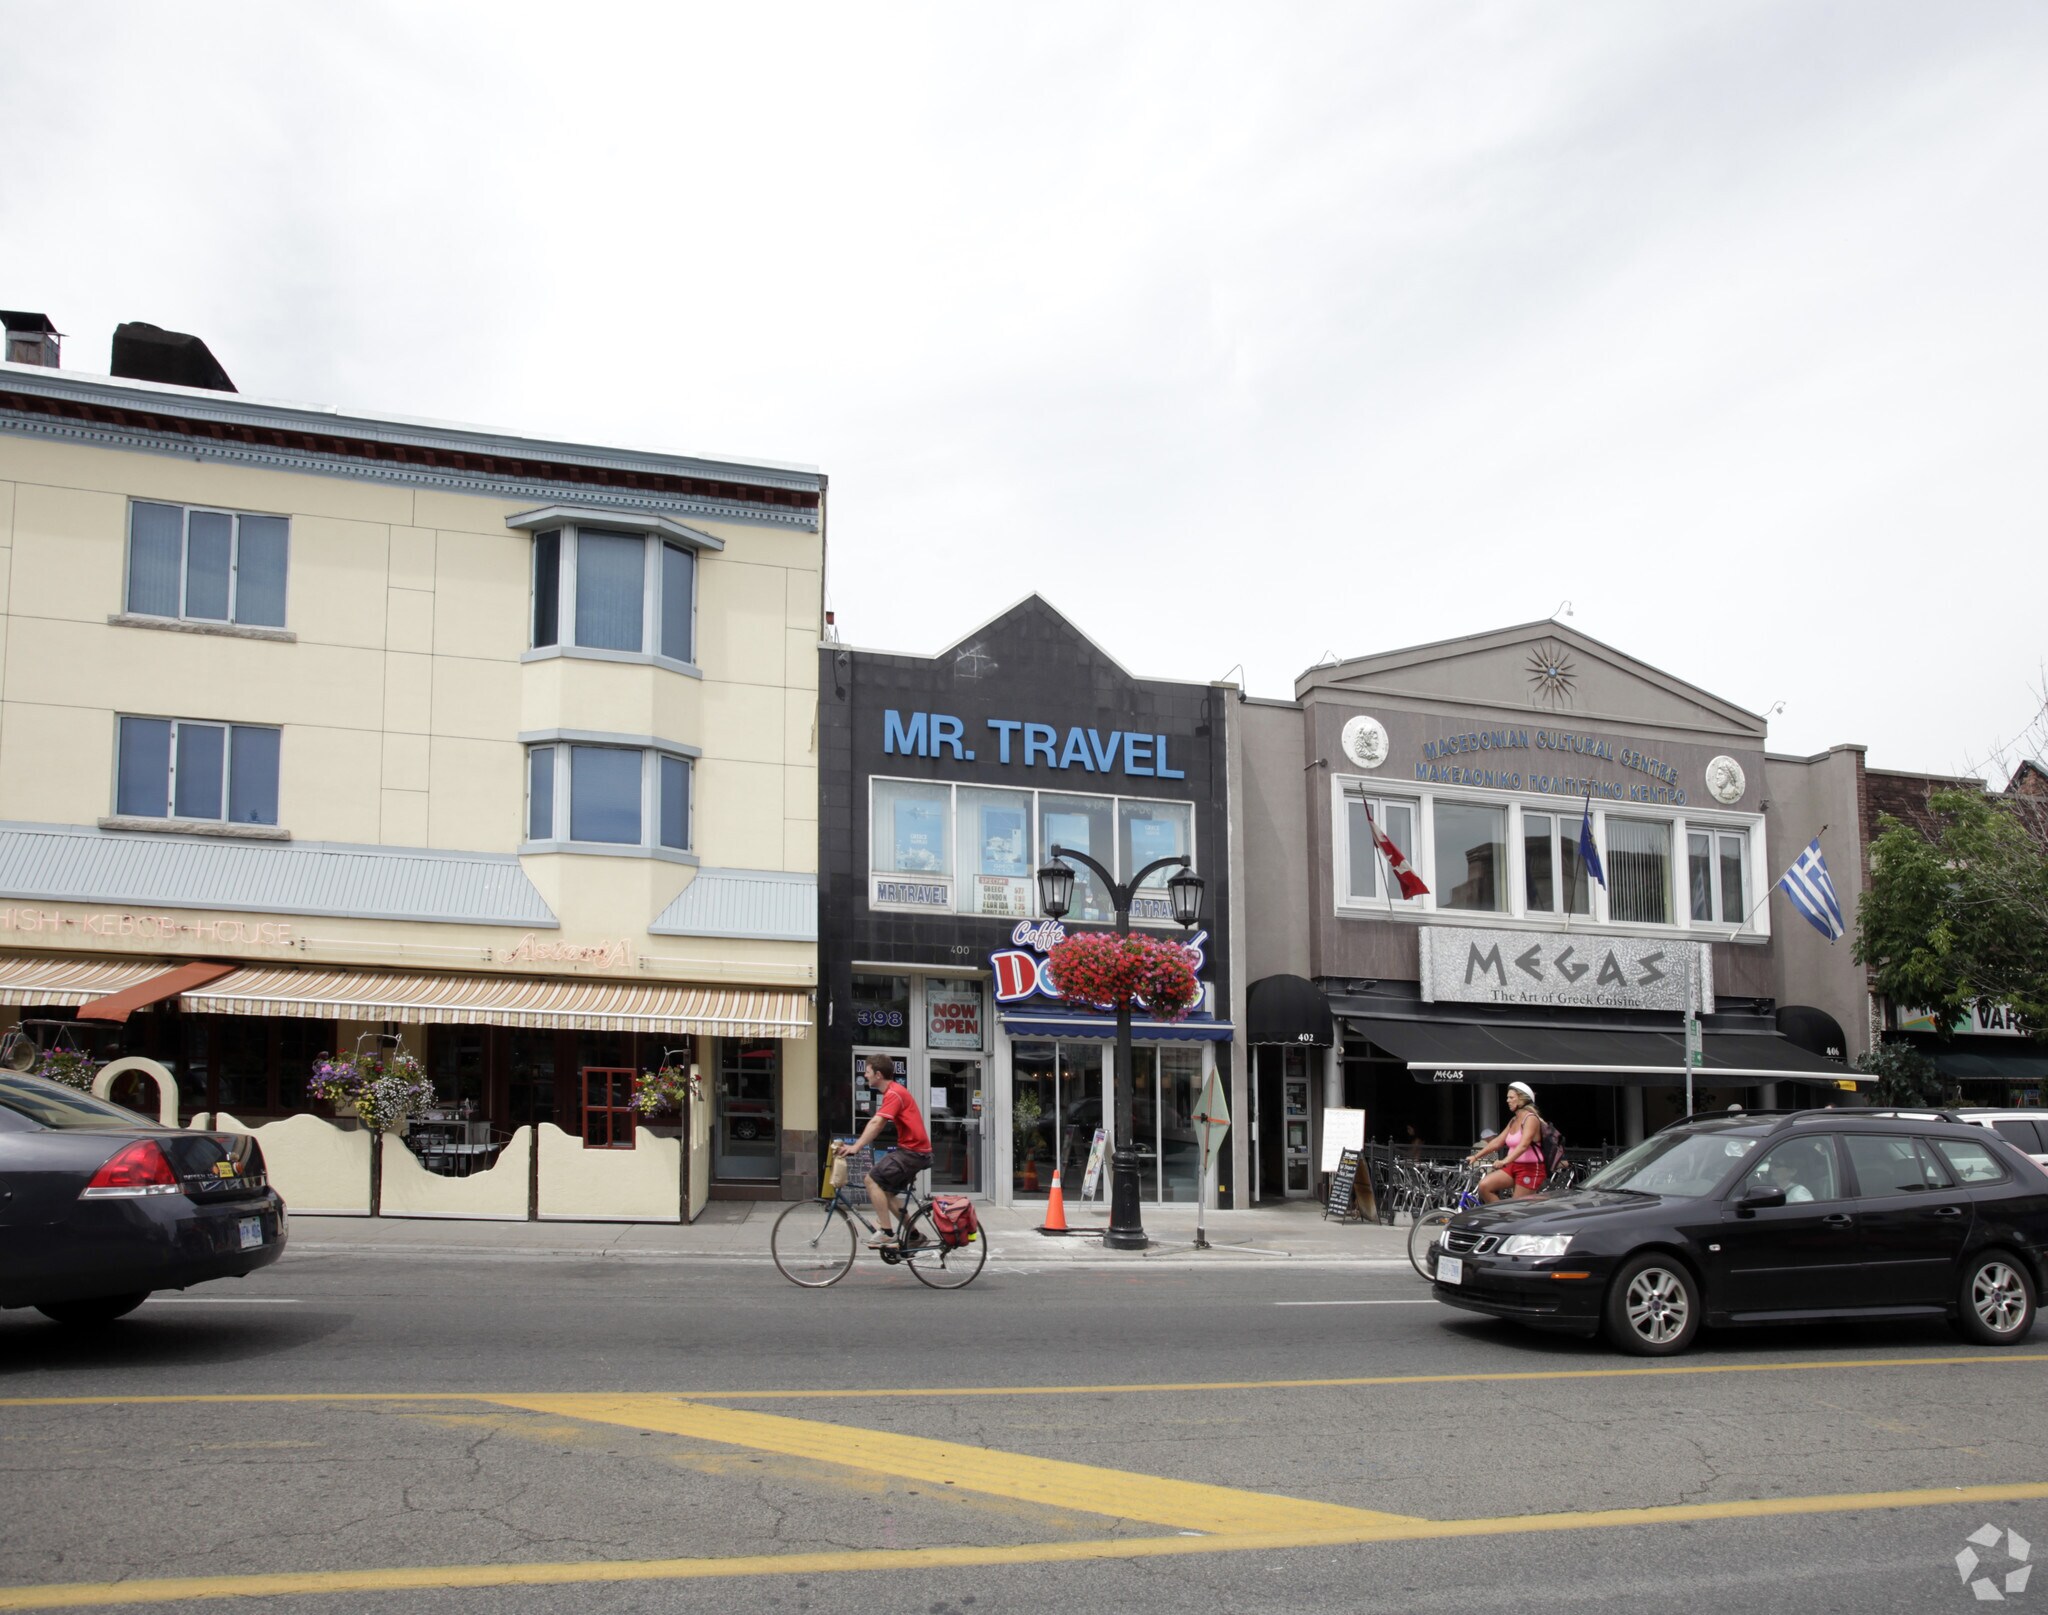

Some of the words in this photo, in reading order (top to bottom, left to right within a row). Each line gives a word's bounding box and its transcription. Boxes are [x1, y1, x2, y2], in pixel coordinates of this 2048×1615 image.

[884, 709, 975, 760] MR.
[987, 719, 1185, 779] TRAVEL
[1423, 730, 1529, 760] MACEDONIAN
[1535, 730, 1614, 761] CULTURAL
[1620, 747, 1679, 786] CENTRE
[878, 883, 896, 901] MR
[899, 884, 947, 904] TRAVEL
[983, 893, 1007, 901] LONDON
[982, 901, 1009, 909] FLORIDA
[83, 913, 176, 938] KEBOB
[196, 919, 292, 944] HOUSE
[950, 945, 970, 955] 400
[1464, 941, 1666, 987] MEGAS
[1490, 989, 1515, 1001] The
[1520, 991, 1537, 1002] Art
[1541, 991, 1554, 1003] of
[1557, 992, 1593, 1005] Greek
[1596, 994, 1641, 1007] Cuisine
[858, 1010, 903, 1027] 398
[933, 1003, 977, 1019] NOW
[931, 1018, 978, 1034] OPEN
[1298, 1033, 1314, 1042] 402
[1826, 1047, 1840, 1056] 406
[1433, 1070, 1464, 1079] MEGAS
